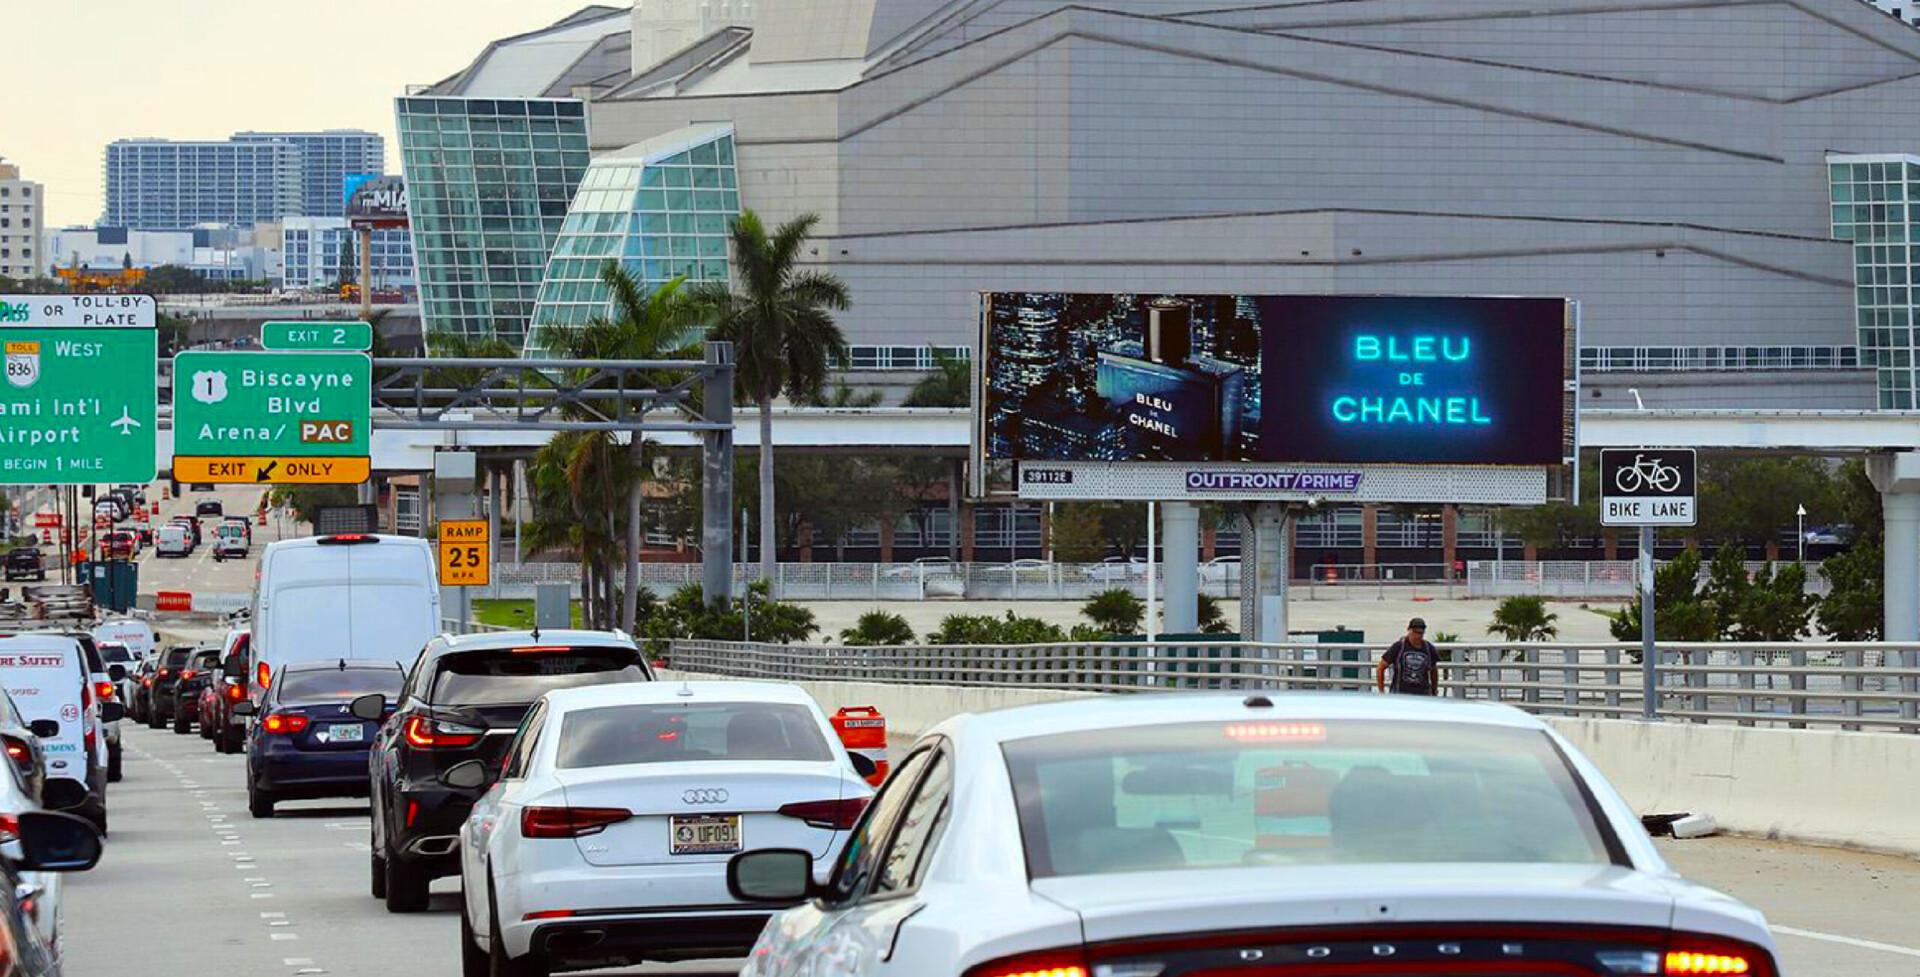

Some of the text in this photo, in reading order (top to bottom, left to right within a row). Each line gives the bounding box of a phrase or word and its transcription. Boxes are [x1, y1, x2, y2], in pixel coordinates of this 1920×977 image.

[73, 296, 148, 308] TOLL-BY-
[43, 305, 64, 316] OR
[83, 314, 136, 326] PLATE
[288, 329, 346, 344] EXIT 2
[1356, 335, 1471, 361] BLEU
[7, 362, 32, 377] 836
[206, 377, 213, 396] 1
[242, 370, 353, 390] Biscayne
[1398, 372, 1424, 386] DE
[268, 397, 320, 413] Blvd
[1136, 392, 1173, 412] BLEU
[1332, 396, 1492, 424] CHANEL
[198, 423, 350, 440] Arena/ PAC
[1129, 413, 1179, 438] CHANEL
[4, 456, 104, 471] BEGIN 1 MILE
[208, 463, 333, 476] EXIT ONLY
[1027, 471, 1067, 482] 39112E
[1609, 502, 1688, 517] BIKE LANE
[446, 527, 483, 537] RAMP
[449, 547, 480, 568] 25
[1241, 941, 1524, 961] DODGE
